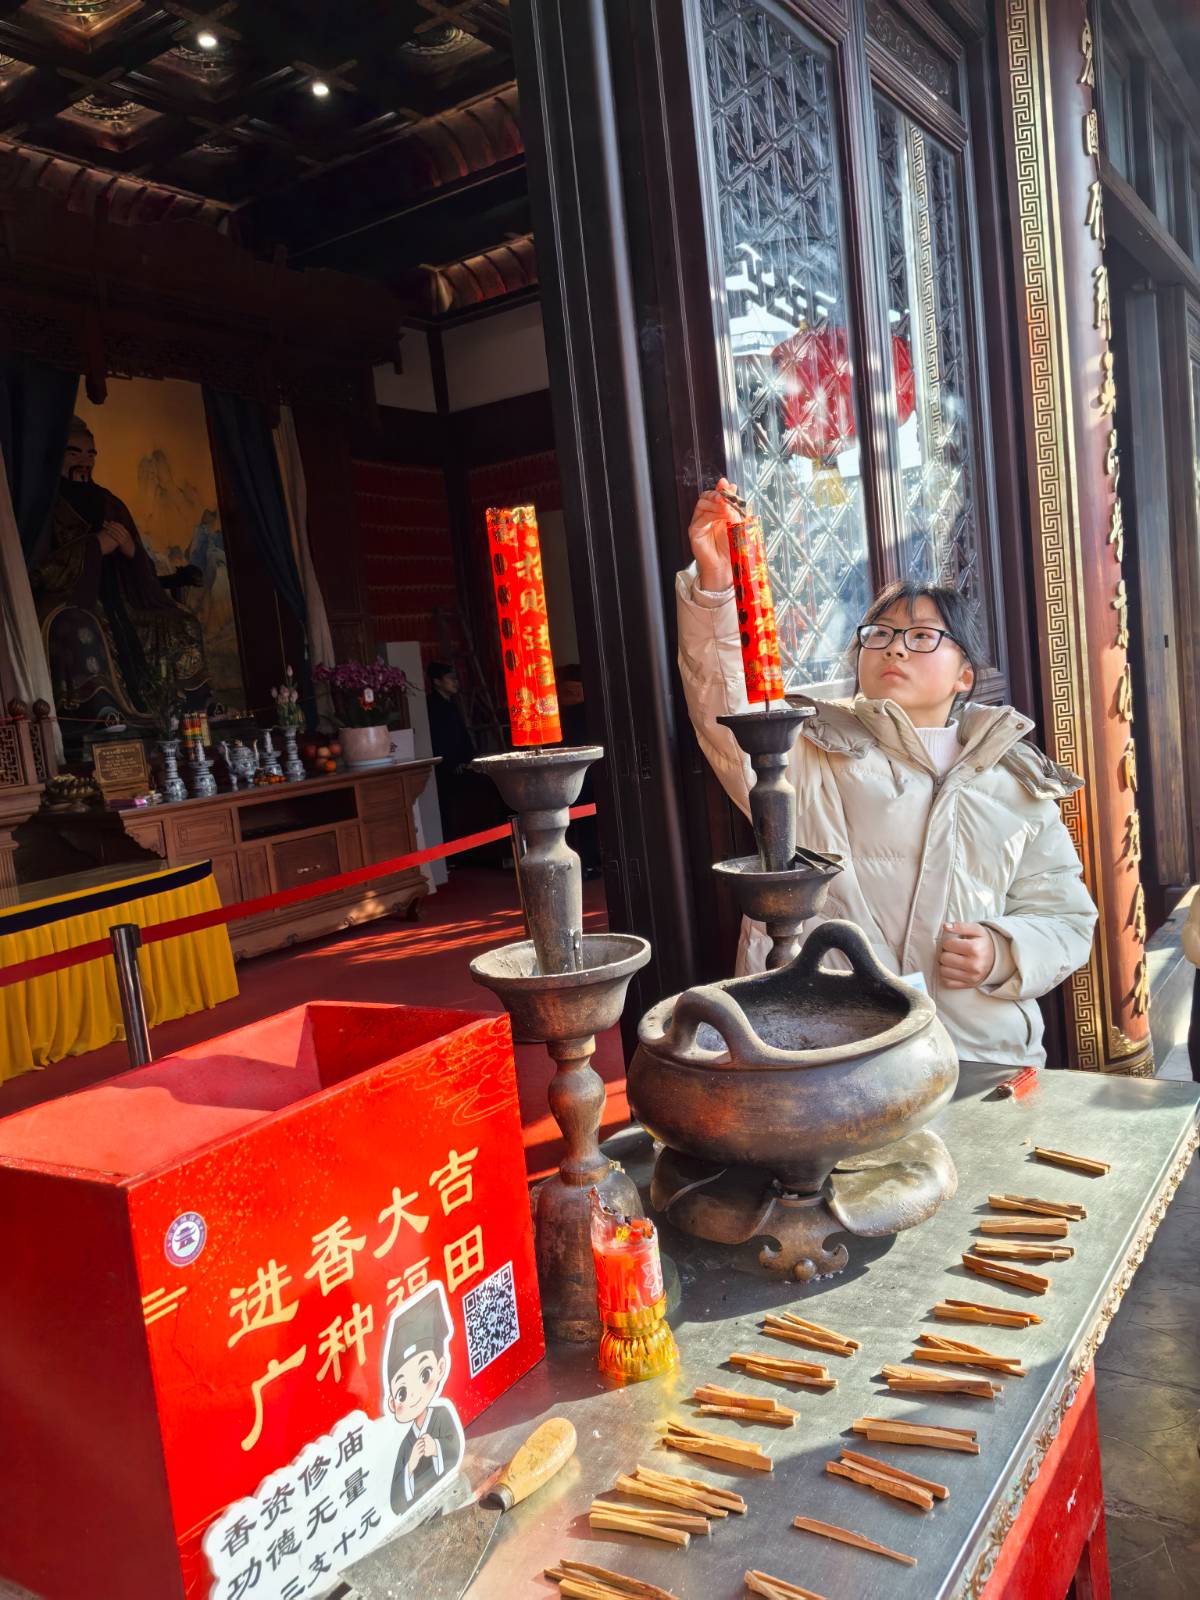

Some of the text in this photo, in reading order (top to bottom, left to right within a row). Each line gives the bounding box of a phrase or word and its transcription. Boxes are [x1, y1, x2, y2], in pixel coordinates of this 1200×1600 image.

[227, 1147, 479, 1348] 进香大吉
[221, 1425, 363, 1557] 香资修庙
[227, 1467, 370, 1600] 功德无量
[281, 1507, 381, 1600] 三支十元
